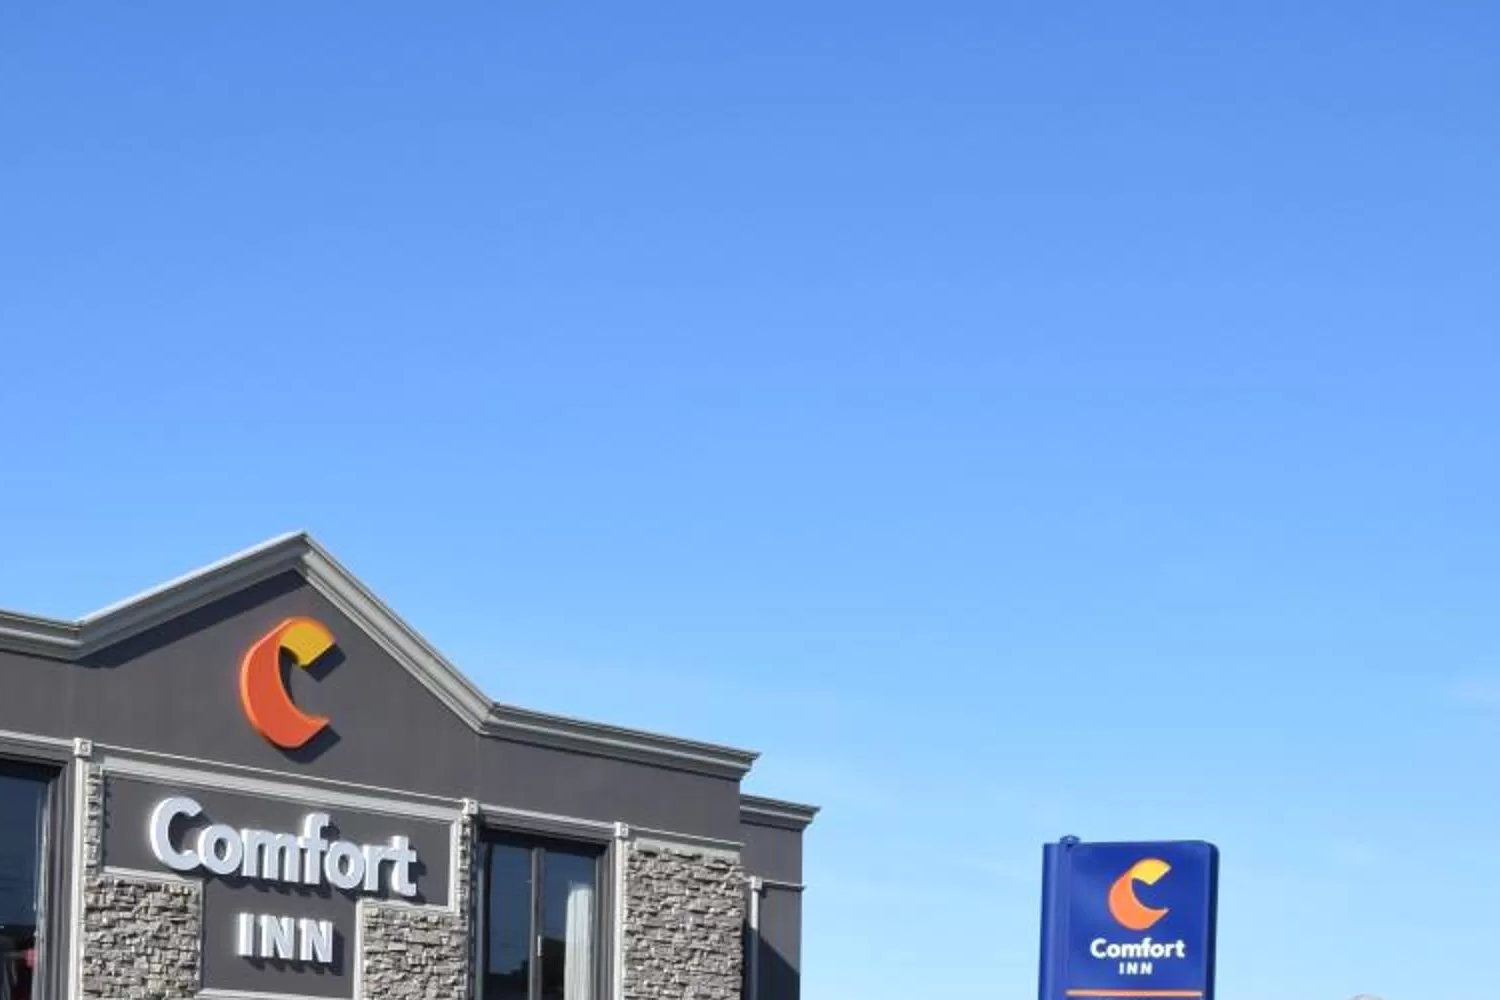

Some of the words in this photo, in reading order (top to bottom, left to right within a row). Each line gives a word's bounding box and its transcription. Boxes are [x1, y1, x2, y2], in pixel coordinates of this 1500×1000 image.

[151, 796, 417, 897] Comfort
[237, 912, 333, 963] INN
[1090, 937, 1185, 959] Comfort
[1119, 961, 1152, 975] INN
